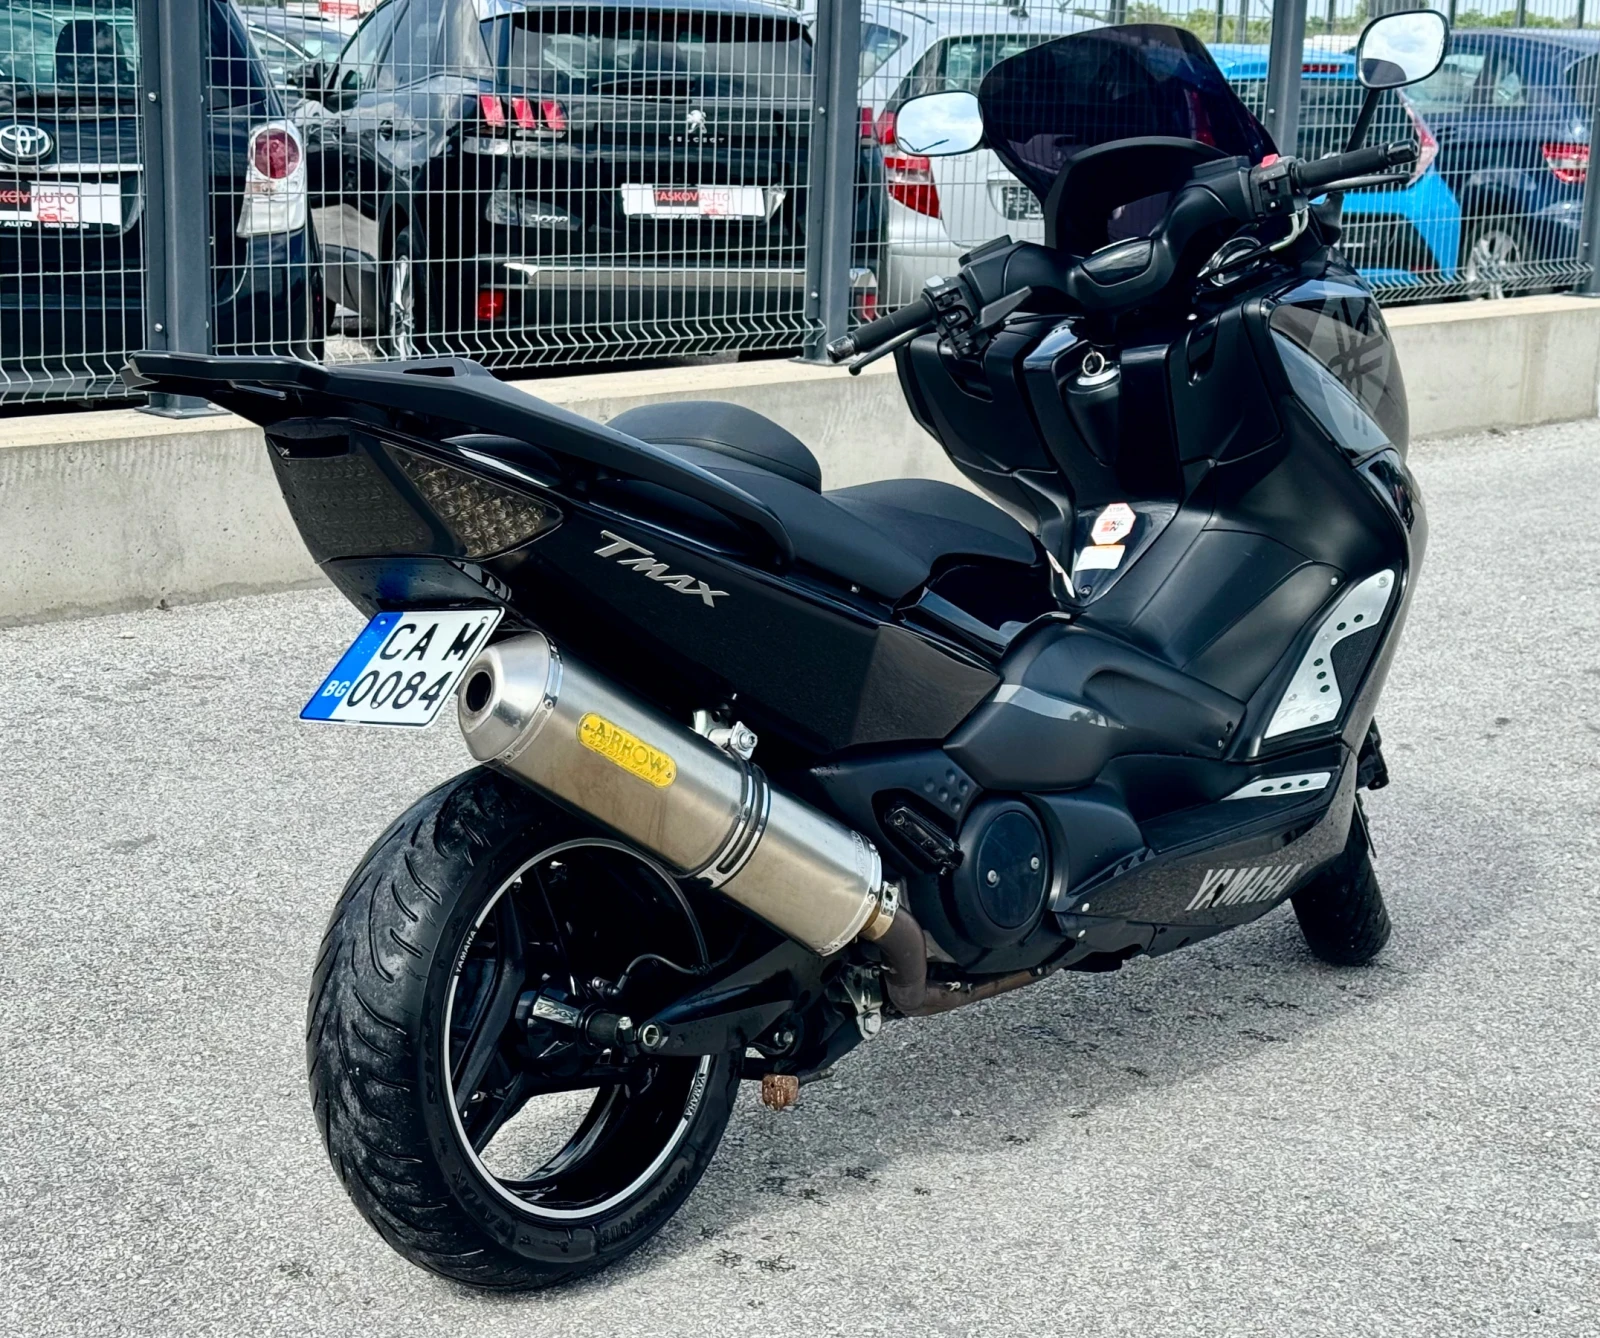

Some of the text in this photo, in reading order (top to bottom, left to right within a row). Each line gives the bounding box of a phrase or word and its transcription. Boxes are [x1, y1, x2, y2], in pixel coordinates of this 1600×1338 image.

[33, 192, 76, 205] AUTO
[655, 190, 730, 202] TASKOV AUTO
[594, 529, 731, 609] TMAX
[380, 621, 486, 661] CA M
[321, 679, 351, 698] BG
[346, 670, 453, 711] 0084
[589, 721, 669, 776] ARROW
[1184, 863, 1303, 912] YAMAHA
[455, 930, 478, 973] YAMAHA
[684, 1076, 706, 1117] YAMAHA
